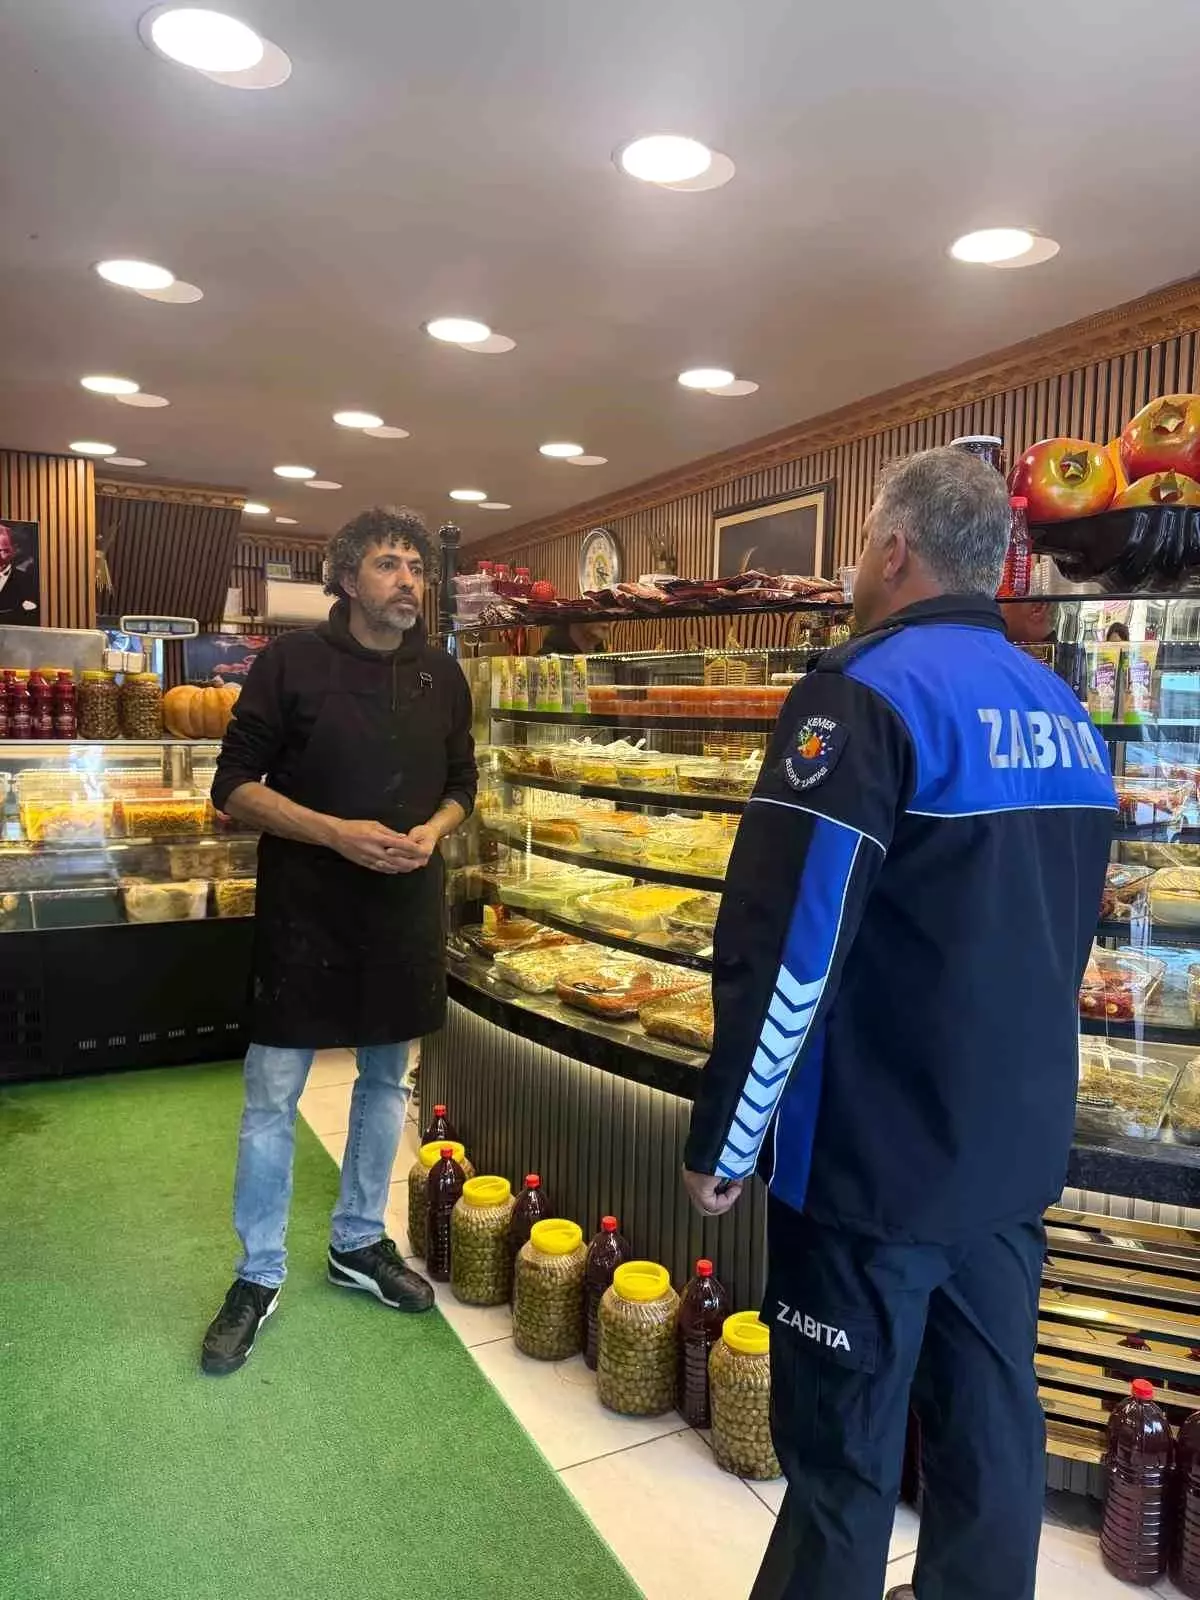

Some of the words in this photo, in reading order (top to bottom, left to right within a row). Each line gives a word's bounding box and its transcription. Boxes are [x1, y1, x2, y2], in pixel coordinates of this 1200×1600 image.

[807, 717, 836, 731] KEMER
[977, 708, 1106, 775] ZABITA
[776, 1300, 851, 1352] ZABITA
